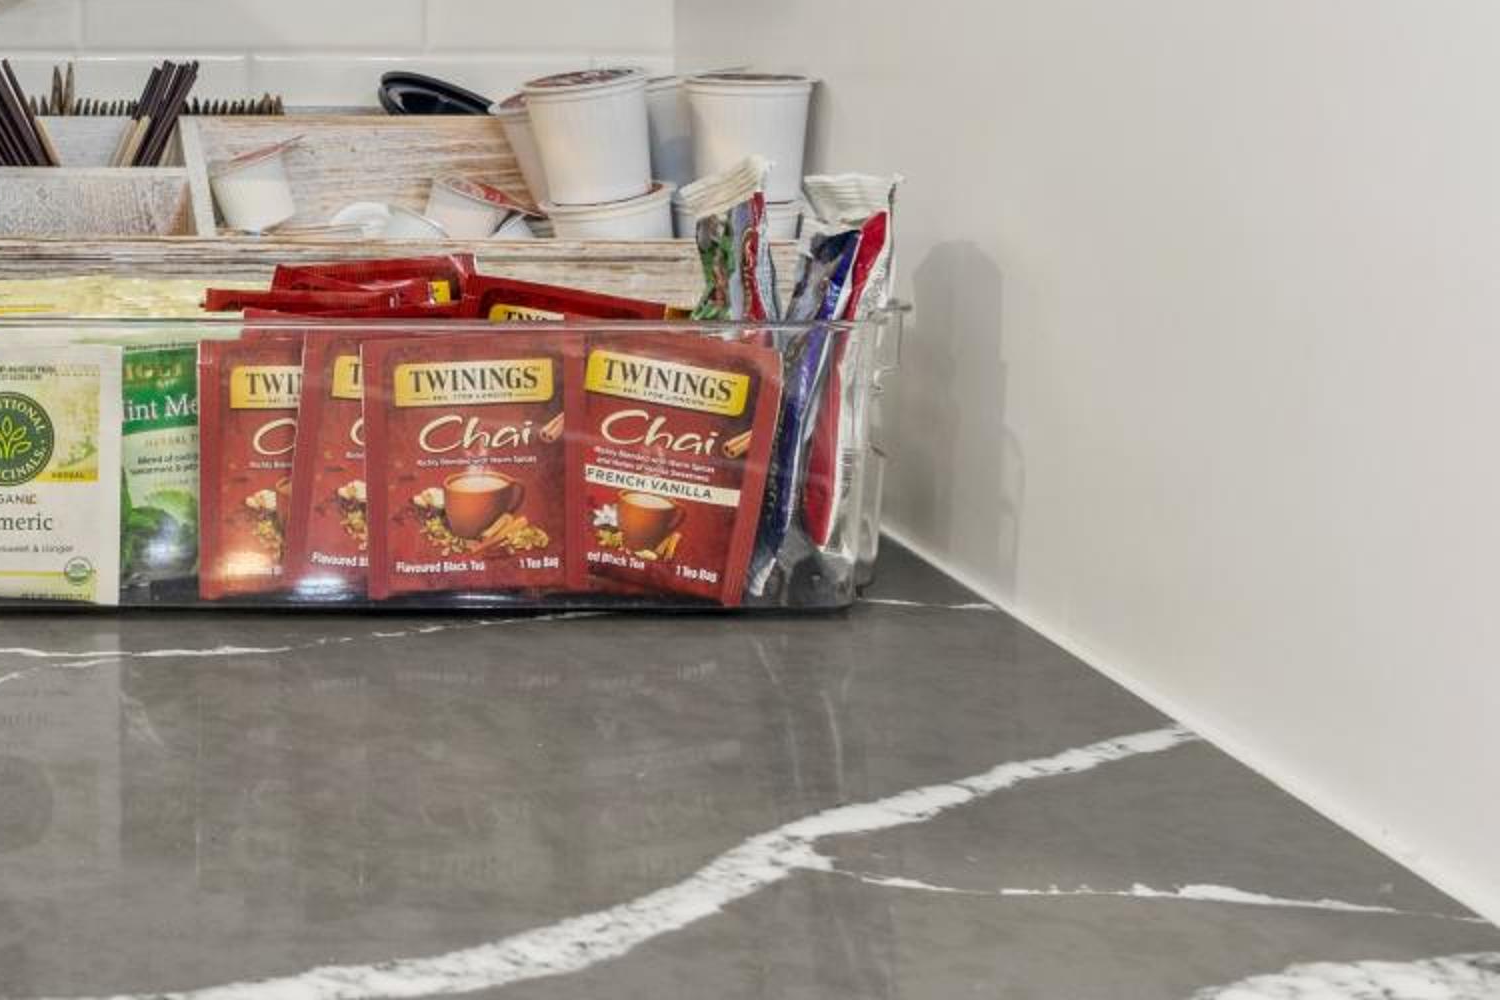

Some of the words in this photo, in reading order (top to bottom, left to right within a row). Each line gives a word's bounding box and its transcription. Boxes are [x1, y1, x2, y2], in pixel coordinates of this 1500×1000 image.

[410, 366, 539, 393] TWININGS
[604, 358, 733, 402] TWININGS
[419, 415, 533, 453] Chai
[601, 409, 719, 455] Chai
[587, 467, 646, 489] FRENCH
[651, 477, 712, 499] VANILLA
[443, 561, 468, 572] Black
